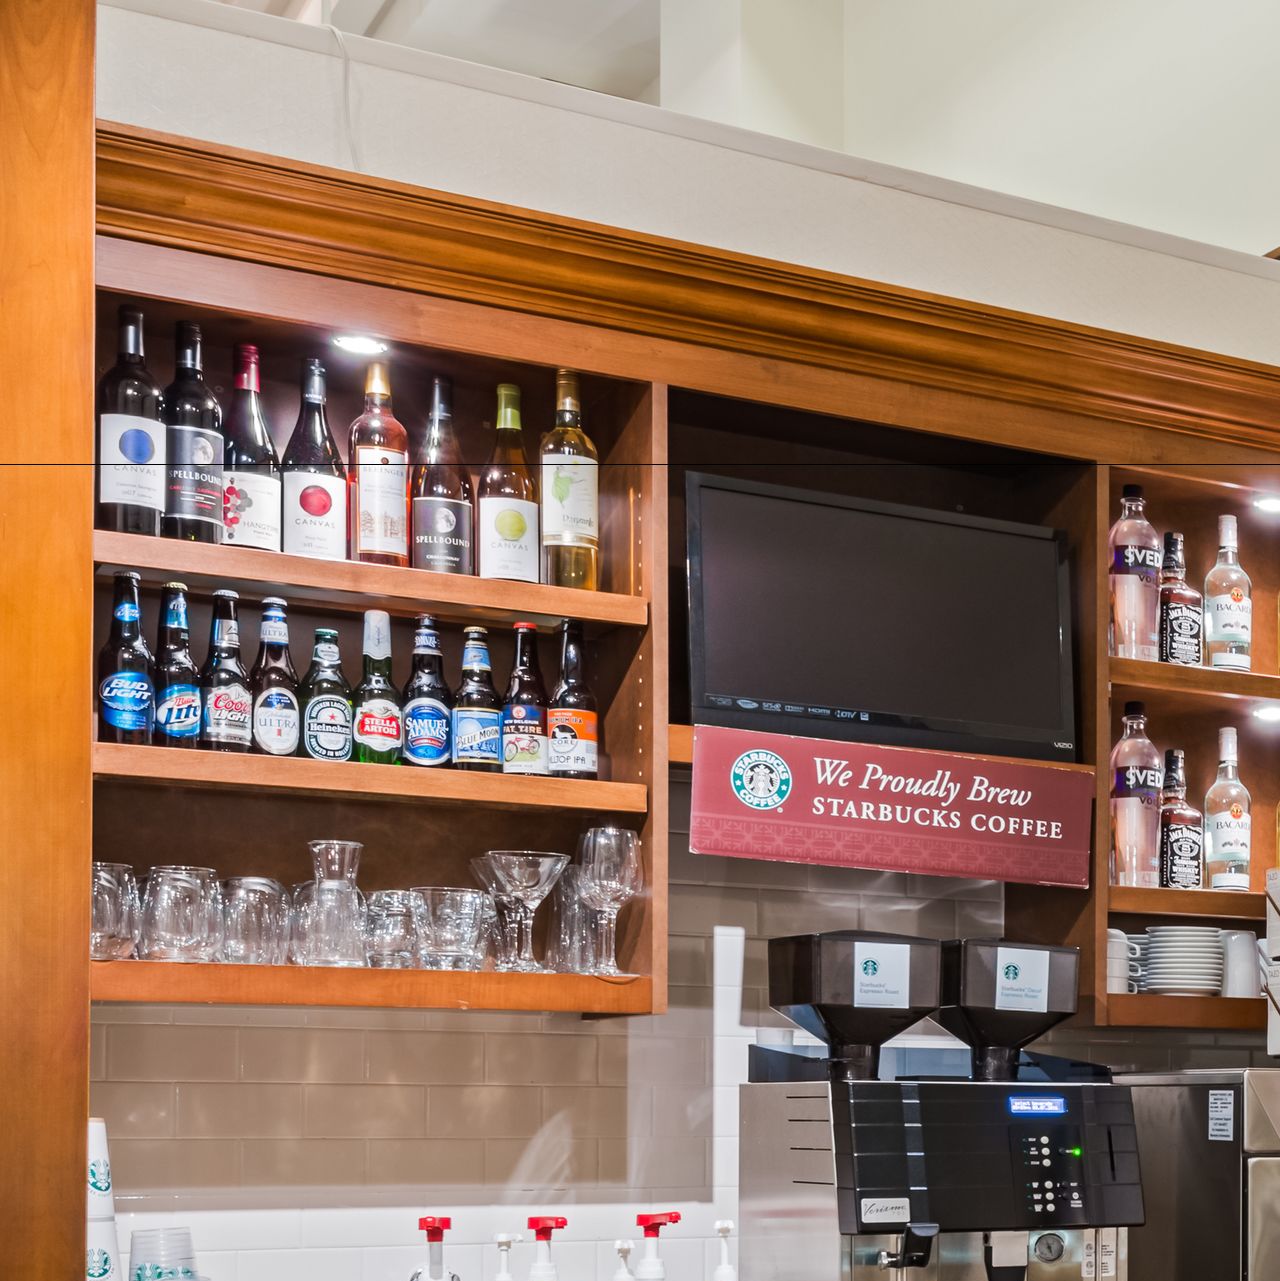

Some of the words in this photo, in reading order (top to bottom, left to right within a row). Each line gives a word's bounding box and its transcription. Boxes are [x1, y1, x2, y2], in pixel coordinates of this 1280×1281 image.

[169, 470, 221, 486] SPELLBOUN
[295, 518, 335, 529] CANVAS
[416, 535, 470, 548] SPELLBOUND
[491, 542, 529, 551] CANVAS
[1124, 546, 1160, 568] SVED
[111, 678, 149, 690] BUD
[103, 687, 151, 700] LIGHT
[213, 693, 250, 712] Coor
[213, 710, 250, 724] LIGHT
[259, 718, 298, 730] ULTRA
[364, 717, 397, 728] STELLA
[405, 717, 449, 731] SAMUEL
[364, 726, 397, 735] ARTOIS
[408, 726, 447, 740] ADAMS
[519, 726, 542, 734] TIRE
[734, 752, 789, 780] STARBUCKS
[812, 757, 851, 788] We
[859, 763, 960, 806] Proudly
[967, 776, 1032, 807] Brew
[1126, 766, 1162, 789] SVED
[739, 788, 782, 807] COFFEE
[812, 796, 961, 829] STARBUCKS
[970, 813, 1063, 840] COFFEE
